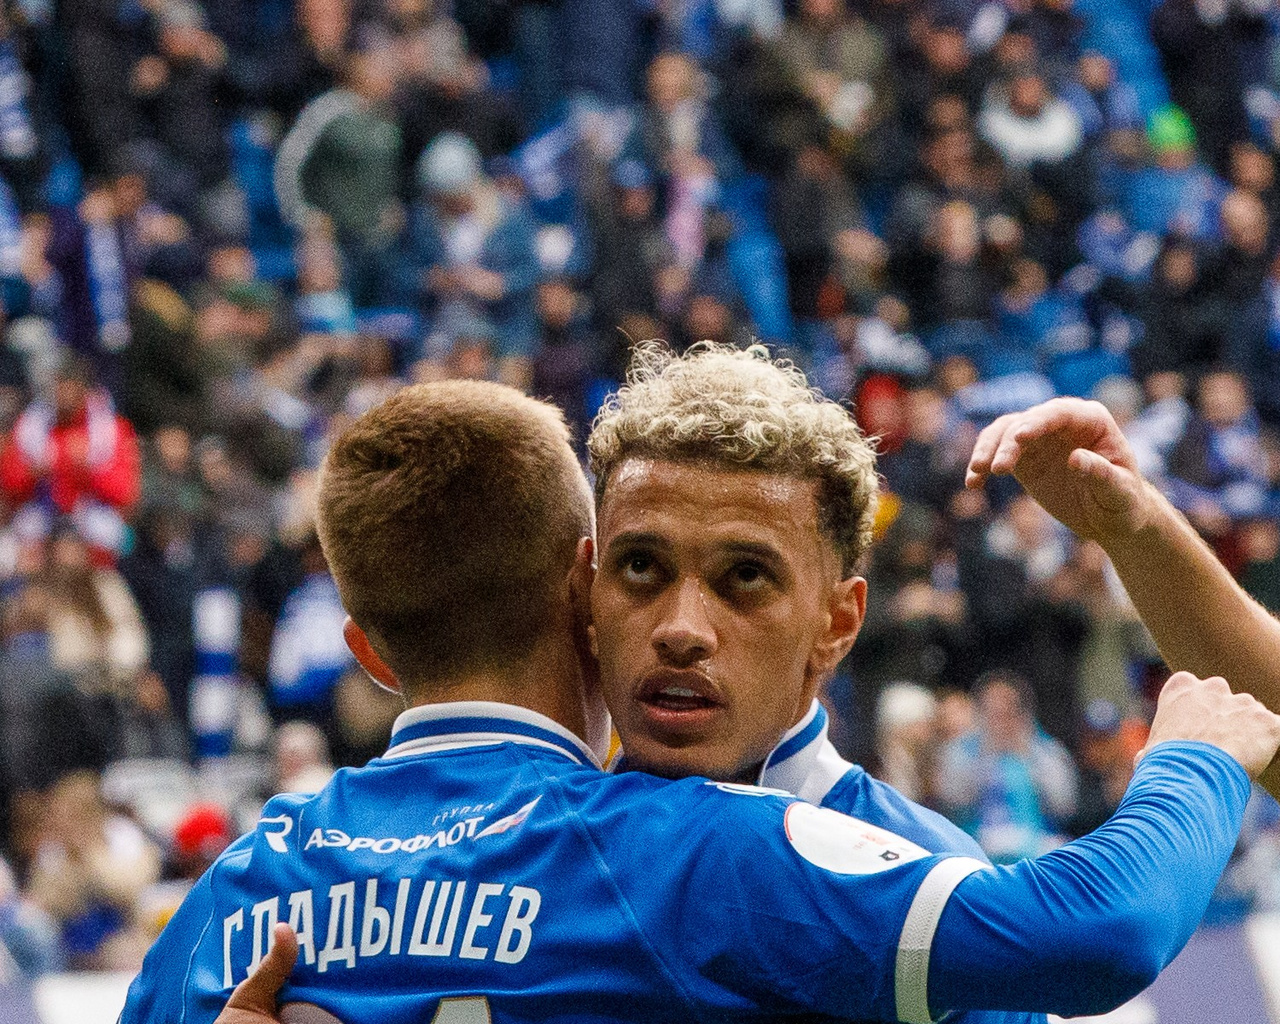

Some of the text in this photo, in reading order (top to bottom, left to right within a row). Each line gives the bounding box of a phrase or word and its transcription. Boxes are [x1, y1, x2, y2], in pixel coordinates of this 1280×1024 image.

[432, 802, 494, 826] ГРУППА
[303, 816, 484, 853] АЭРОФЛОТ
[223, 878, 541, 989] ГЛАДЫШЕВ
